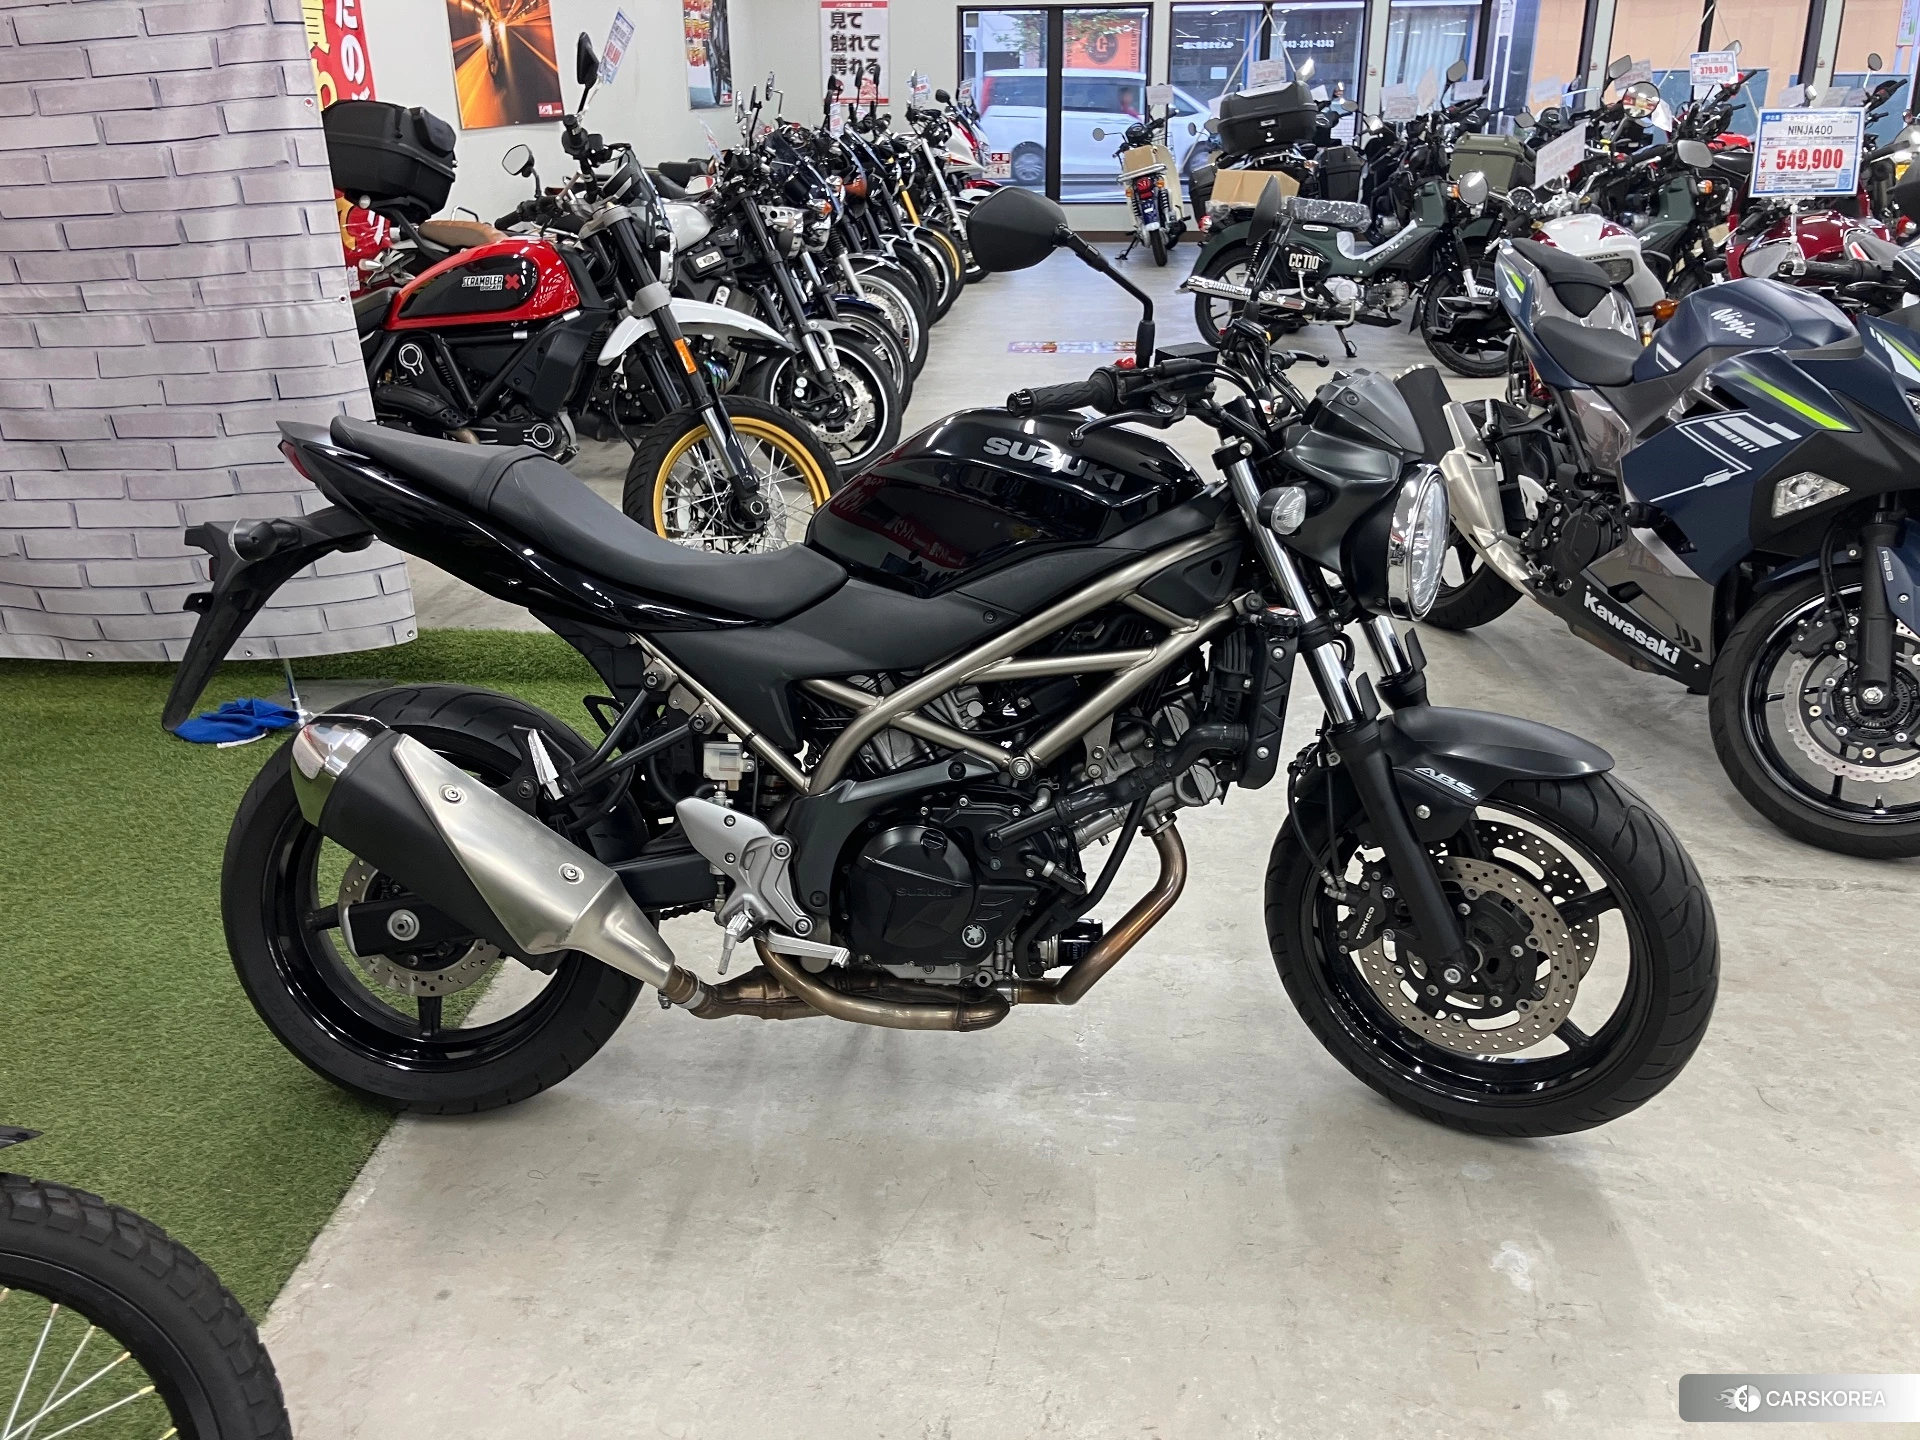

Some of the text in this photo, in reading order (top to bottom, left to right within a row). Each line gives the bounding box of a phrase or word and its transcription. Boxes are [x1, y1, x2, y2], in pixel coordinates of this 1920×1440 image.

[830, 11, 862, 29] 見て
[830, 34, 881, 52] 触れて
[1788, 125, 1833, 135] NINJA400
[1776, 148, 1844, 171] 549,900
[462, 275, 503, 287] SCRAMBLER
[1710, 308, 1756, 339] Ninja
[983, 436, 1126, 492] SUZUKI
[1583, 591, 1681, 665] Kawasaki
[1414, 767, 1476, 794] ABS
[896, 886, 952, 897] SUZUKI
[1355, 906, 1375, 940] TOKICO
